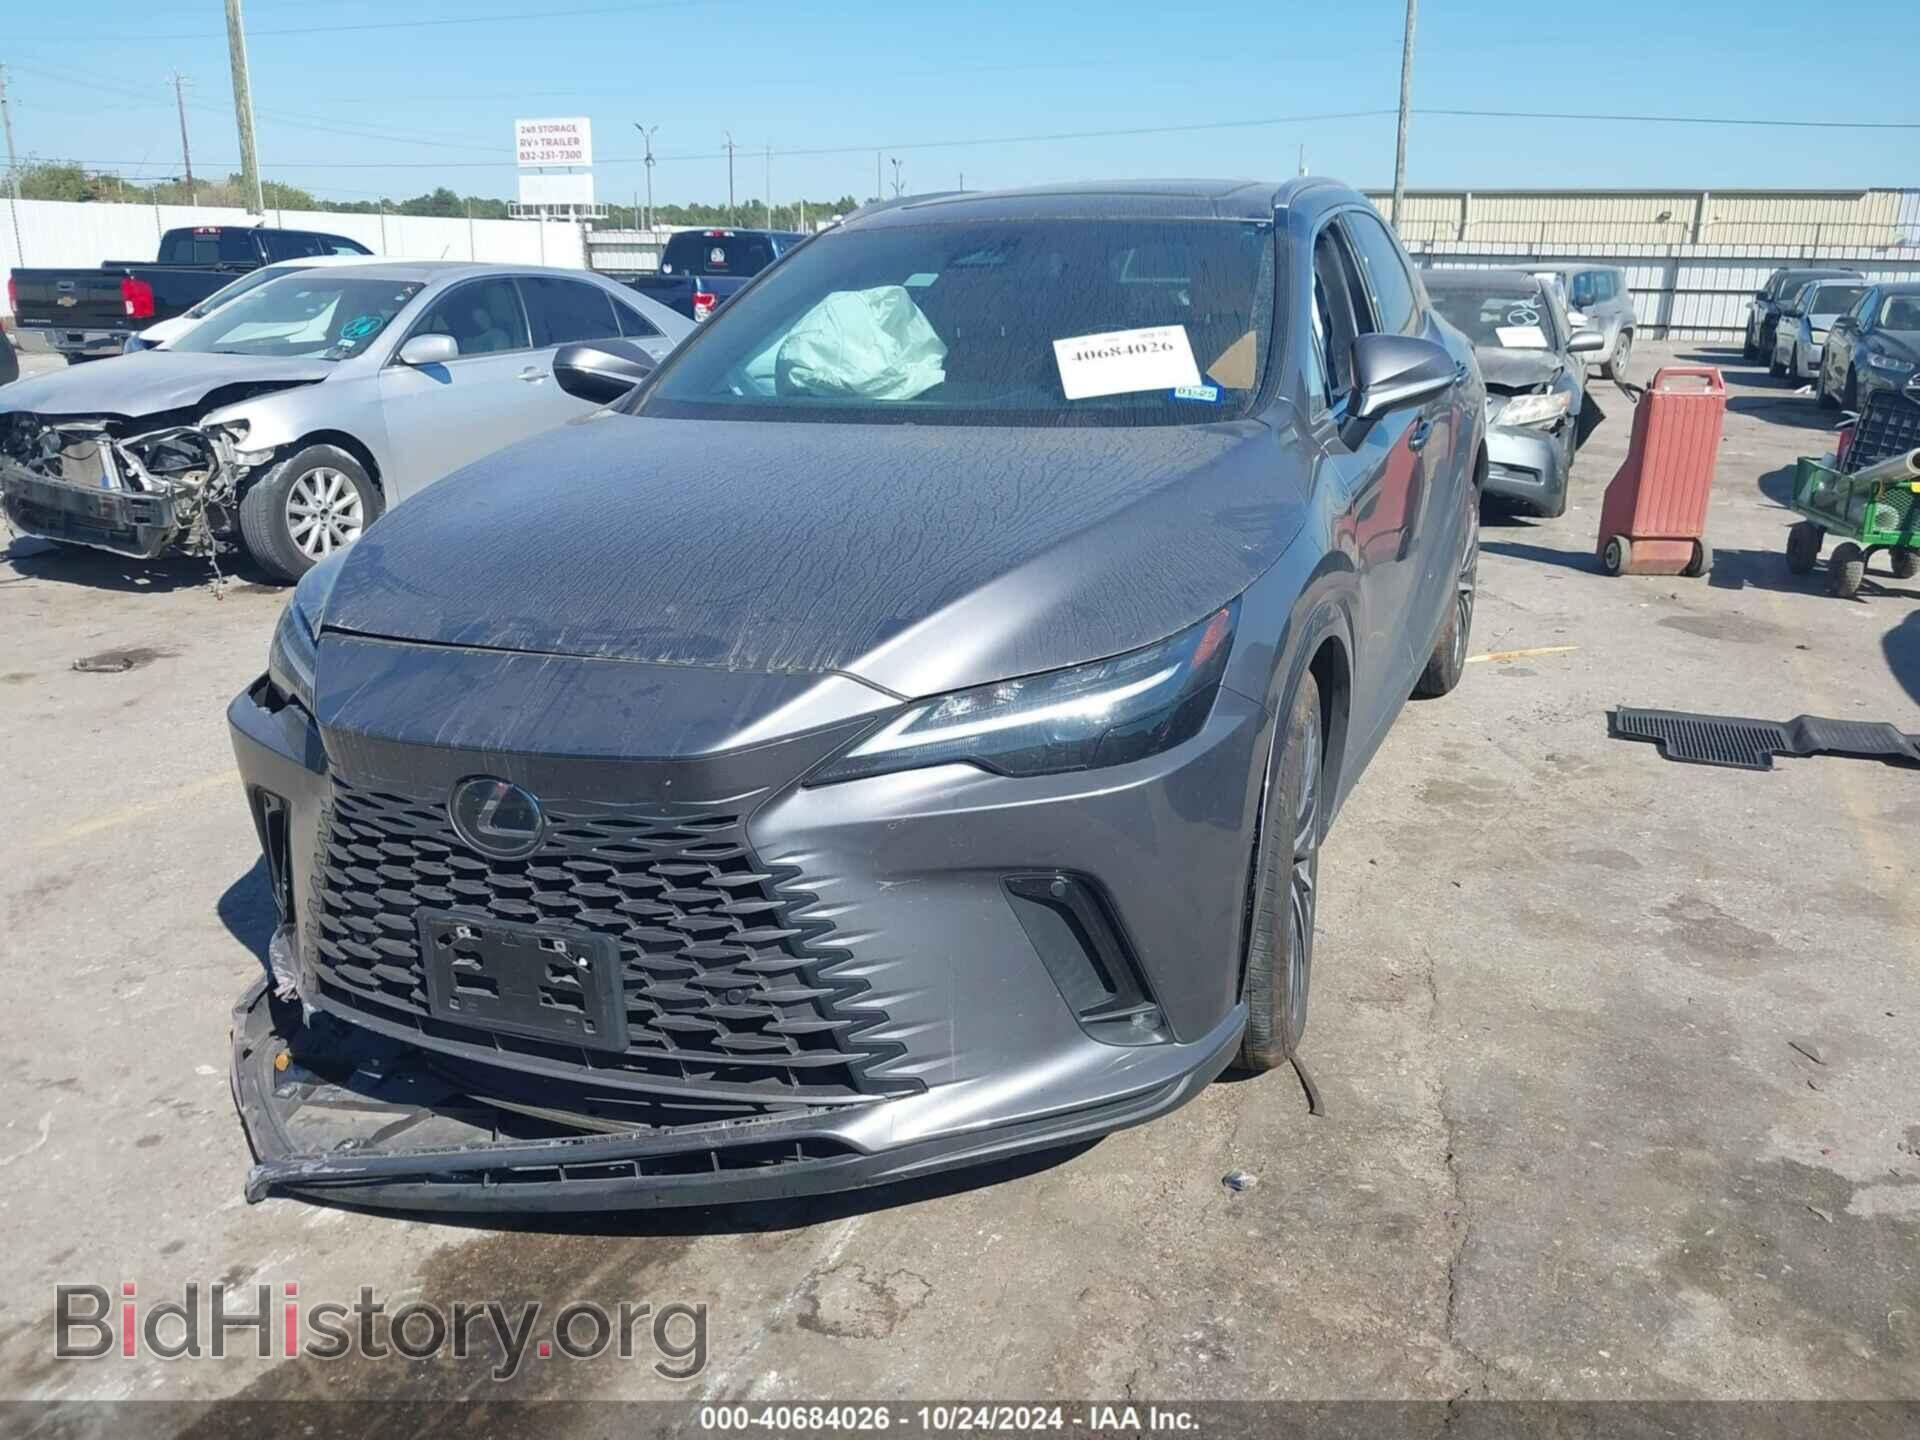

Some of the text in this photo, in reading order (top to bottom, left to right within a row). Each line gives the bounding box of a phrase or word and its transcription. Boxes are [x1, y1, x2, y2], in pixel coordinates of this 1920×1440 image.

[538, 124, 577, 133] STORAGE
[540, 137, 580, 146] TRAILER
[1071, 341, 1174, 362] 40684026
